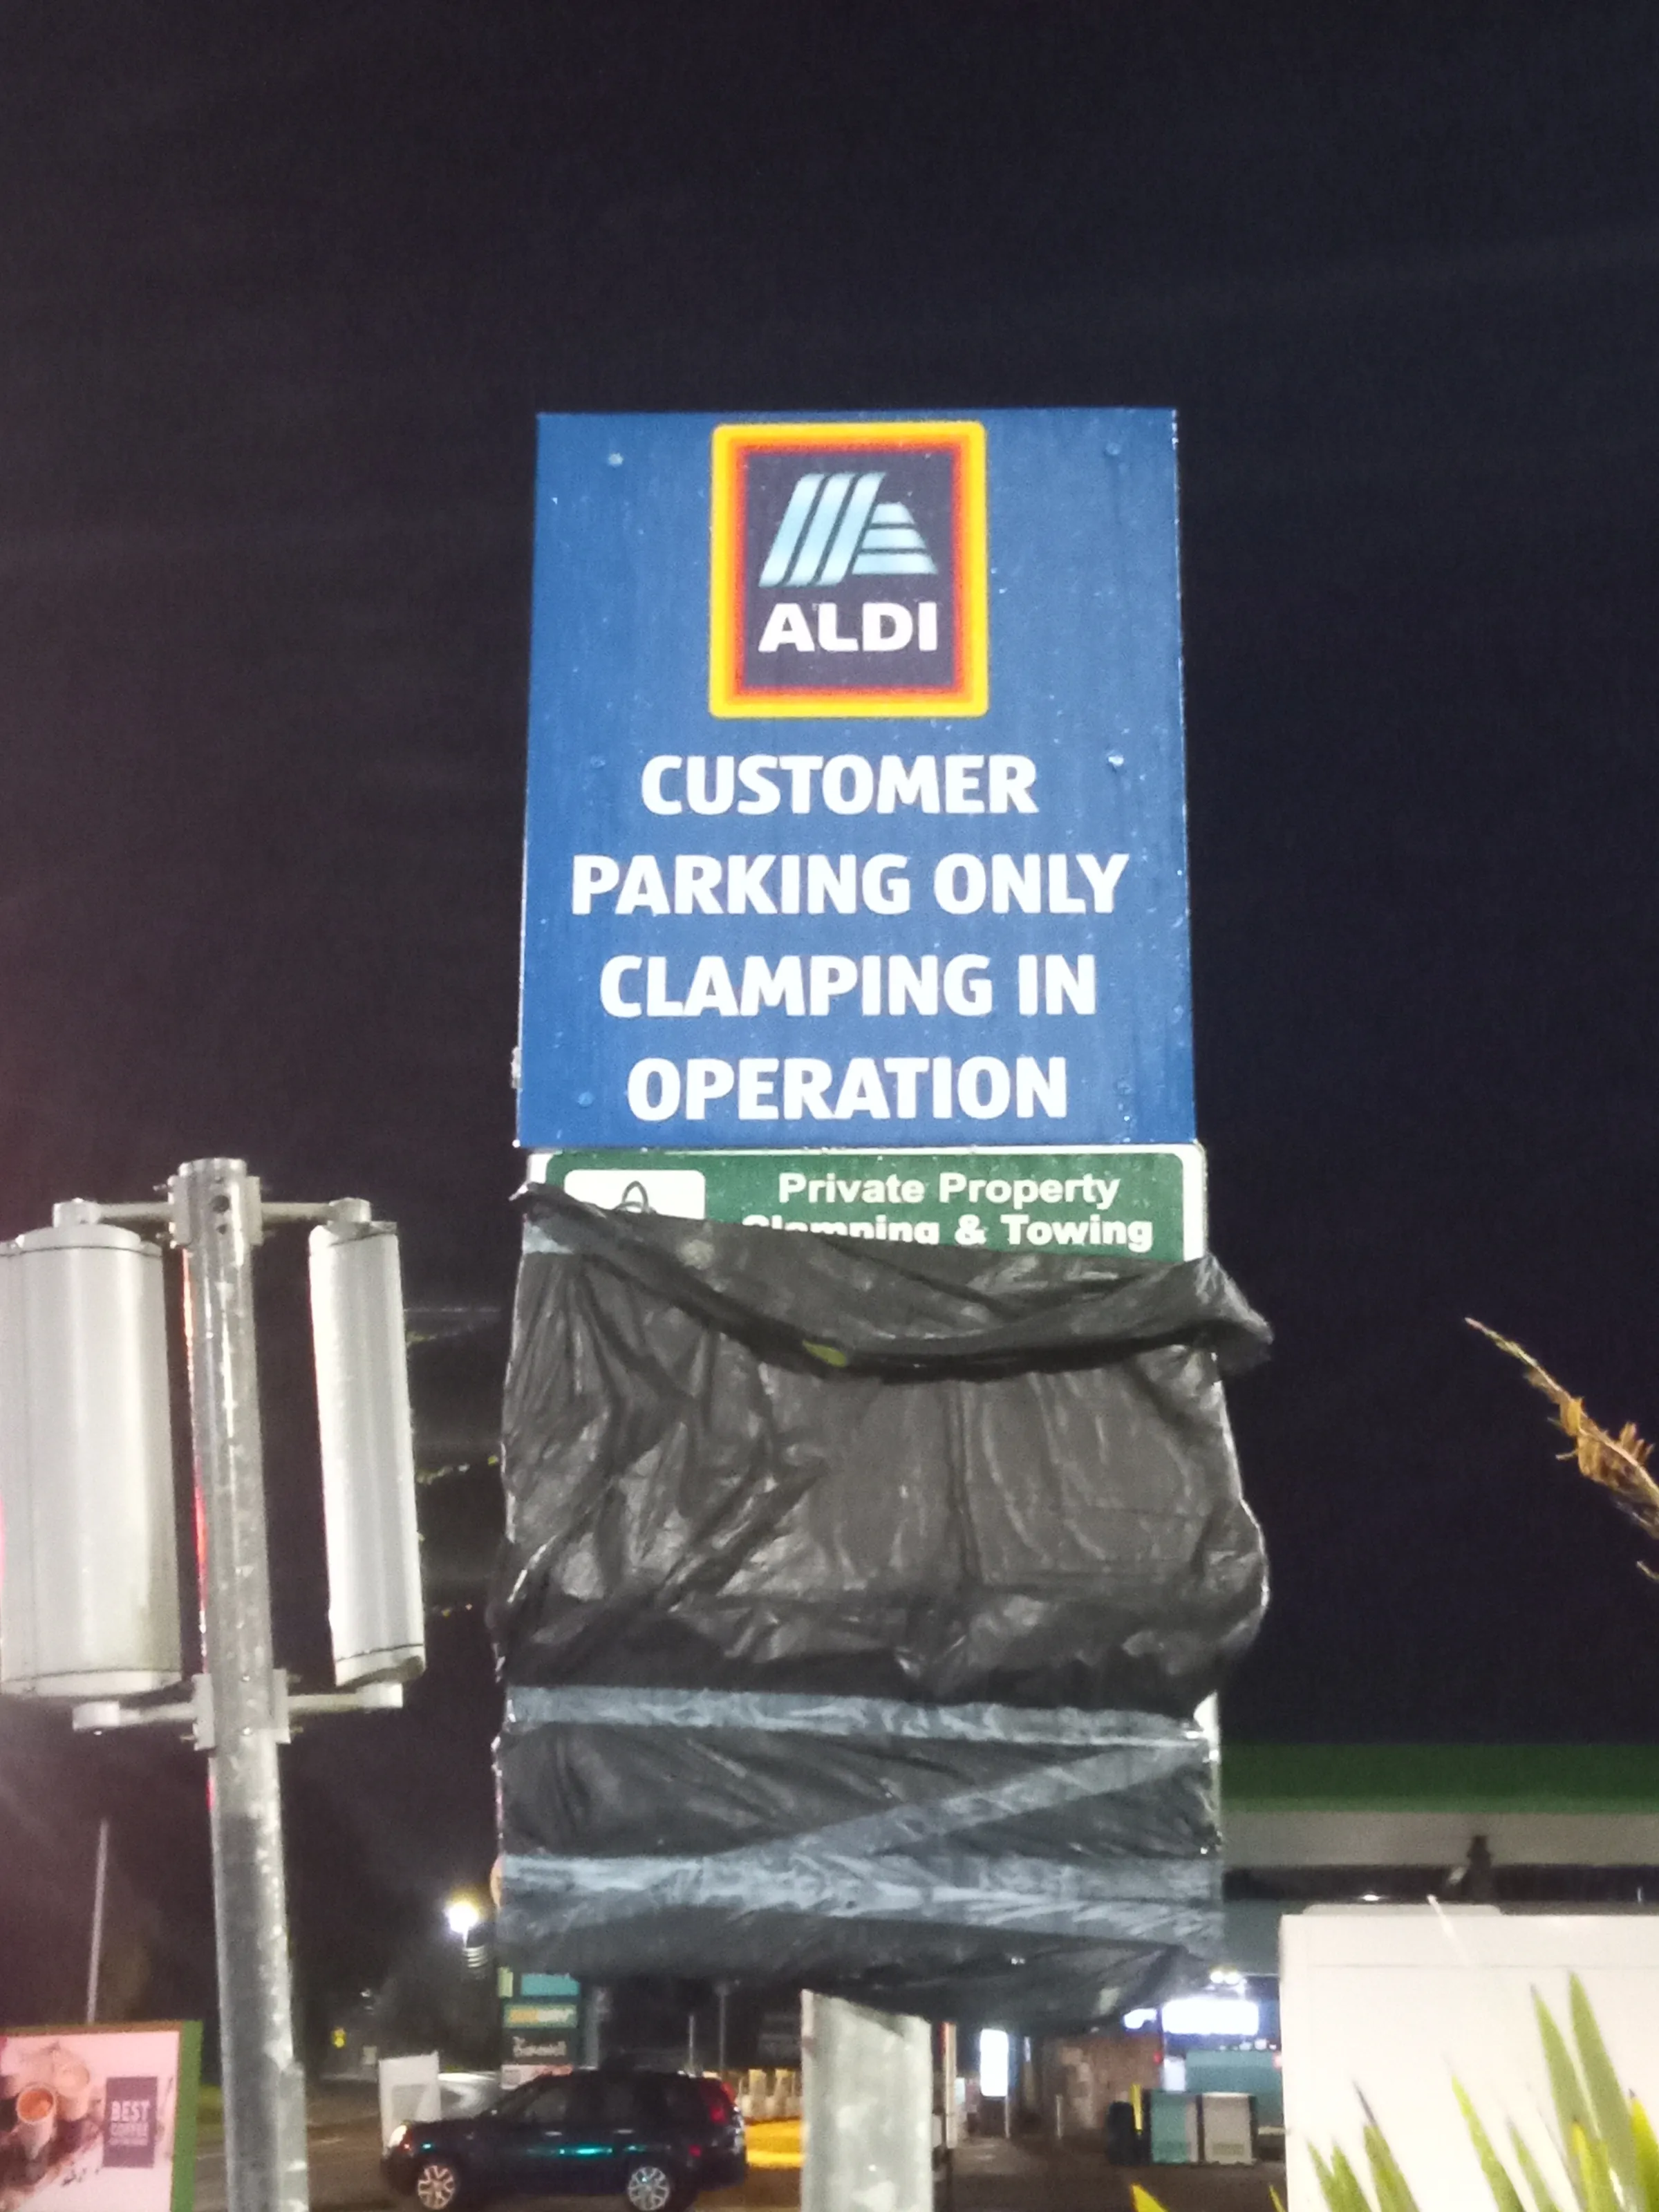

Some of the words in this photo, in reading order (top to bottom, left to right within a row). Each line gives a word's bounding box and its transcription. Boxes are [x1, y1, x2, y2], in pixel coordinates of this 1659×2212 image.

[758, 601, 937, 653] ALDI
[641, 753, 1038, 815] CUSTOMER
[572, 854, 910, 916] PARKING
[934, 853, 1129, 915] ONLY
[601, 954, 993, 1018] CLAMPING
[1018, 954, 1096, 1016] IN
[628, 1055, 1067, 1121] OPERATION
[779, 1172, 925, 1203] Private
[939, 1172, 1121, 1210] Property
[955, 1214, 986, 1246] &
[1000, 1214, 1152, 1253] Towing
